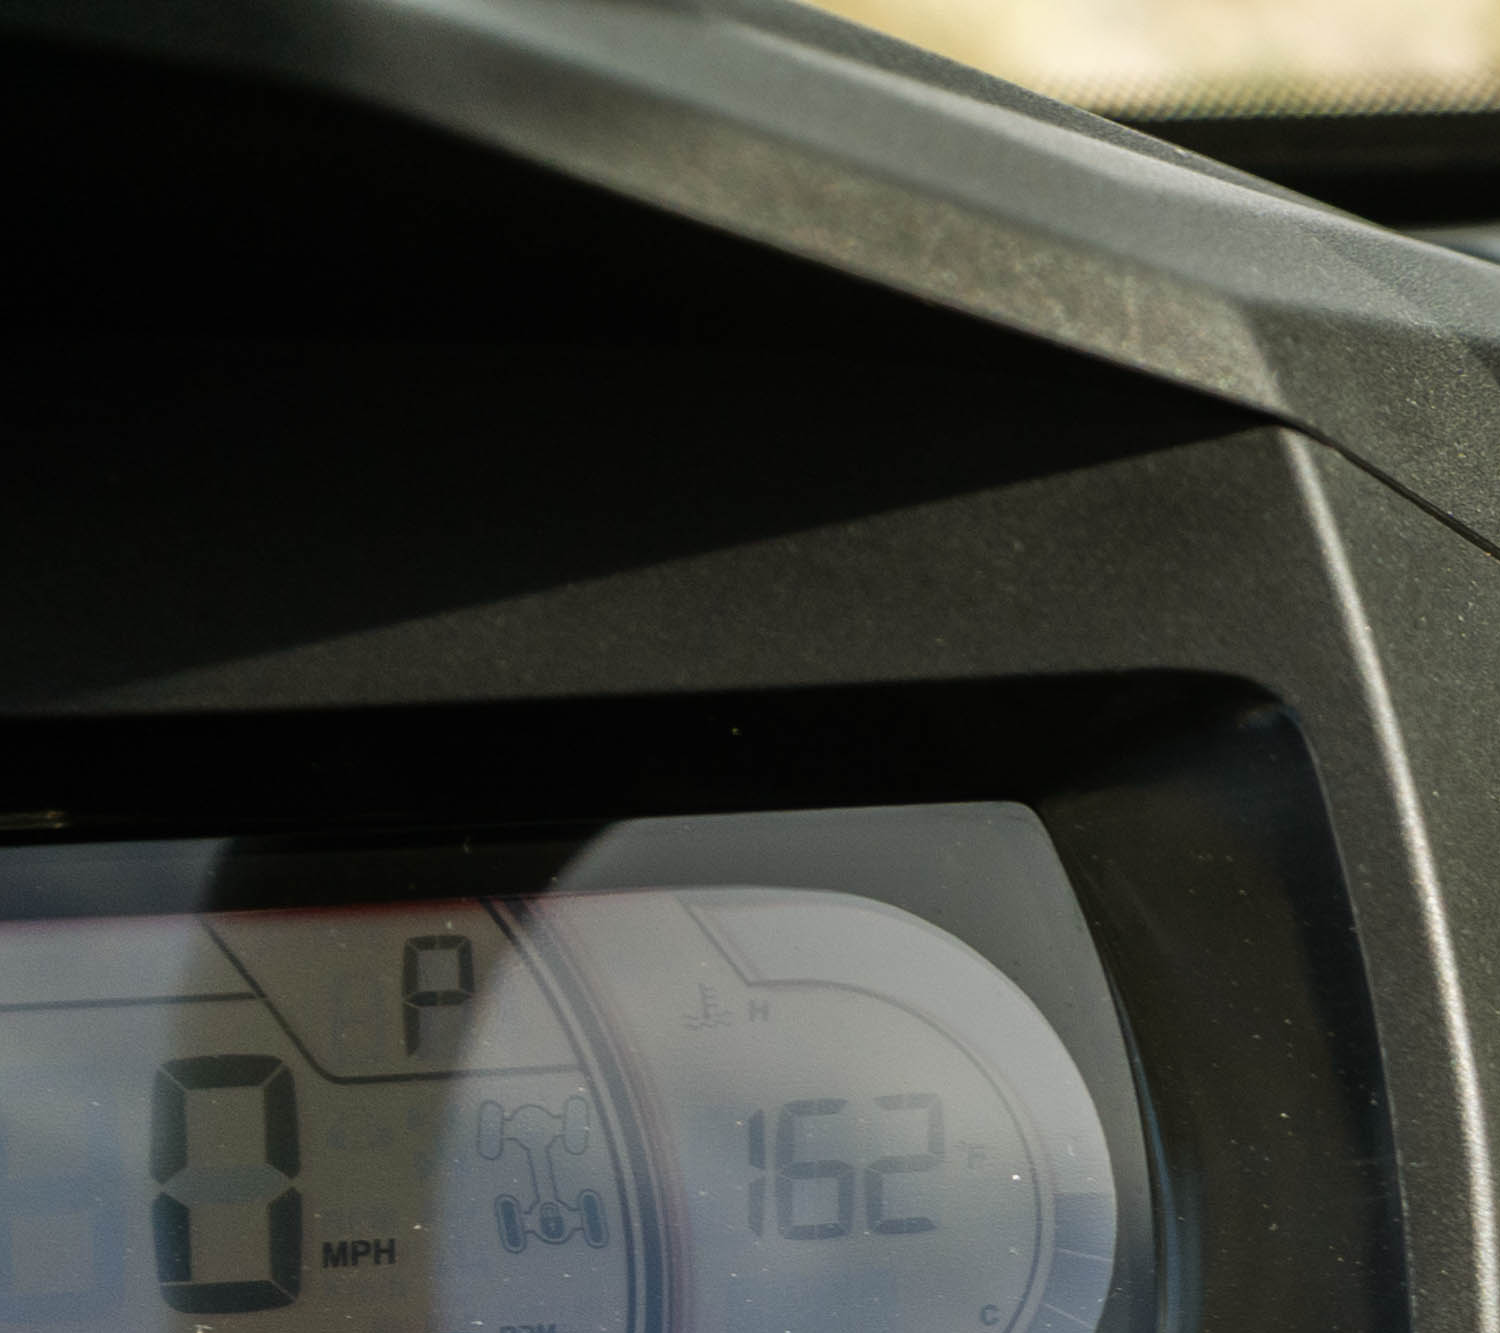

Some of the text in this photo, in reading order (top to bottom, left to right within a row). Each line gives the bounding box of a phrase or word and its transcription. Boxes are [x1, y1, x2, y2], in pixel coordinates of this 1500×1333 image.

[403, 934, 476, 1057] P
[149, 1053, 398, 1315] 0 MPH
[747, 1093, 945, 1241] 162
[980, 1304, 1000, 1326] C
